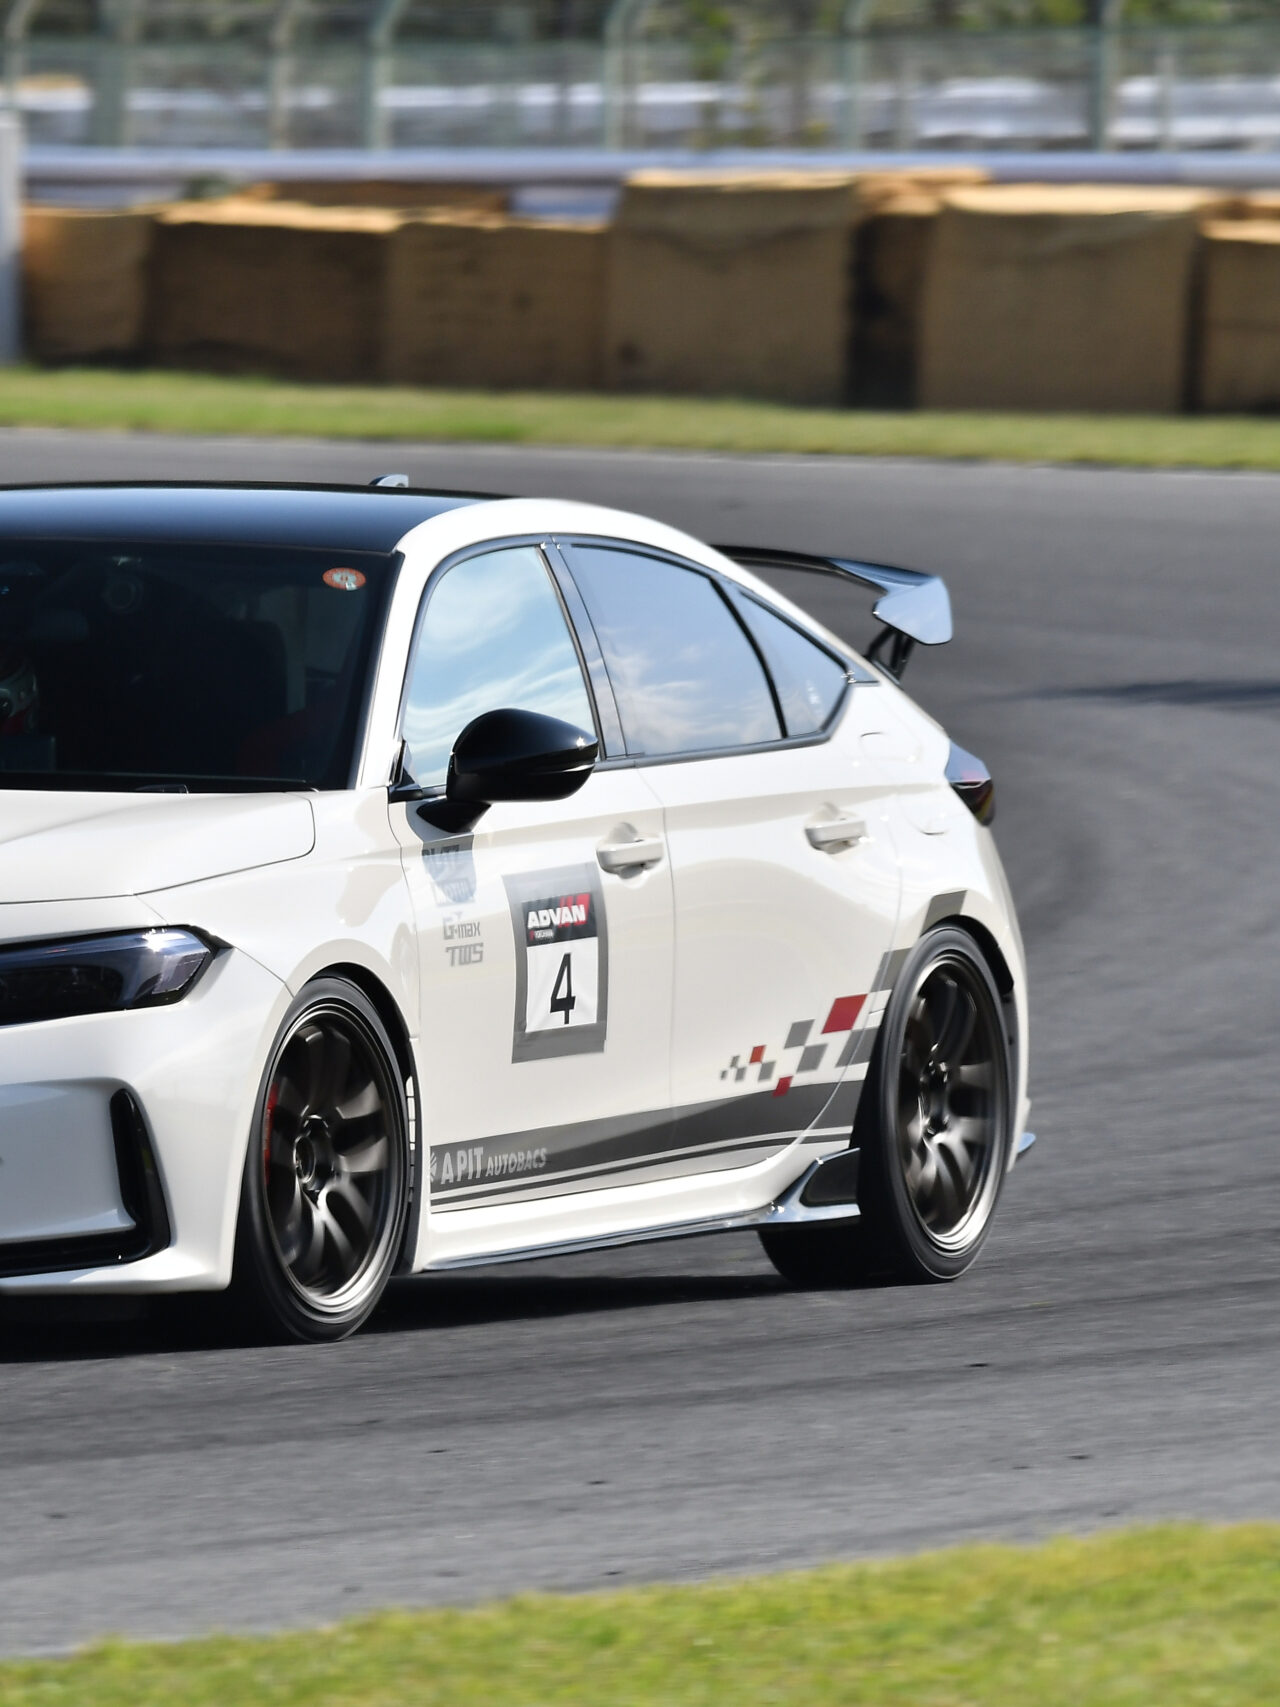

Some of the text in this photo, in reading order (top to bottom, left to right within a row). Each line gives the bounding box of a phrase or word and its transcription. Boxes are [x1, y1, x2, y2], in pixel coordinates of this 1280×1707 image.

[528, 904, 587, 929] ADVAN
[445, 942, 484, 967] TWS
[550, 952, 576, 1025] 4
[485, 1147, 547, 1177] AUTOBACS
